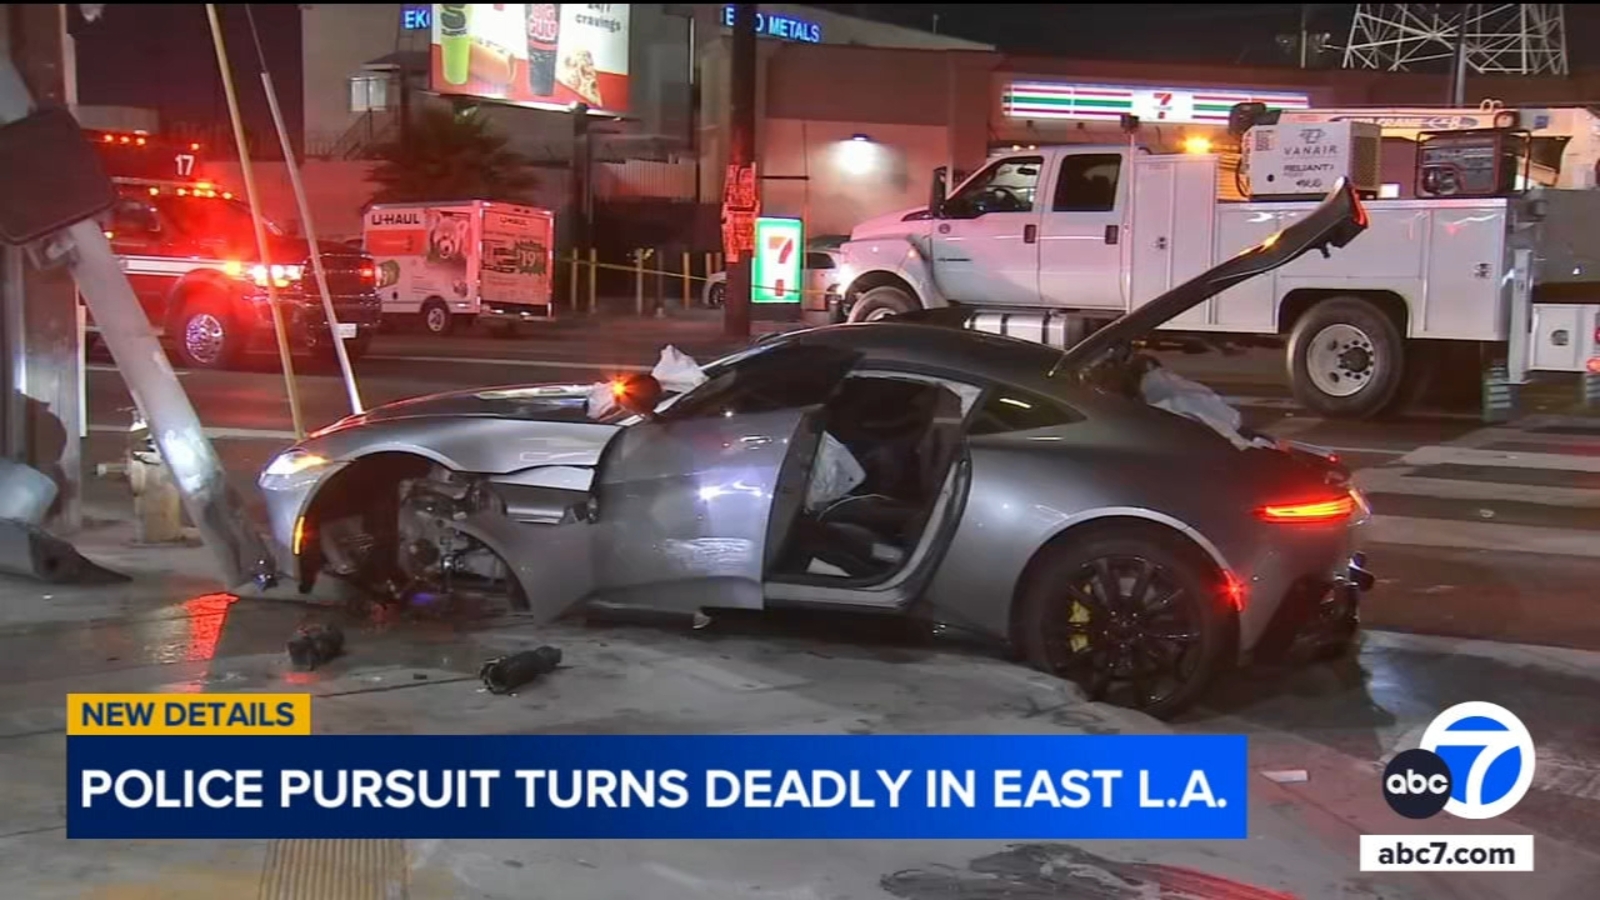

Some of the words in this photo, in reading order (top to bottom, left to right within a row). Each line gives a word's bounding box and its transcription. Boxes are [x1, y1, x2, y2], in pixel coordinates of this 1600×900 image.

[769, 15, 820, 43] METALS
[1284, 145, 1338, 155] VANAIR
[175, 154, 195, 176] 17
[371, 213, 420, 226] U-HAUL
